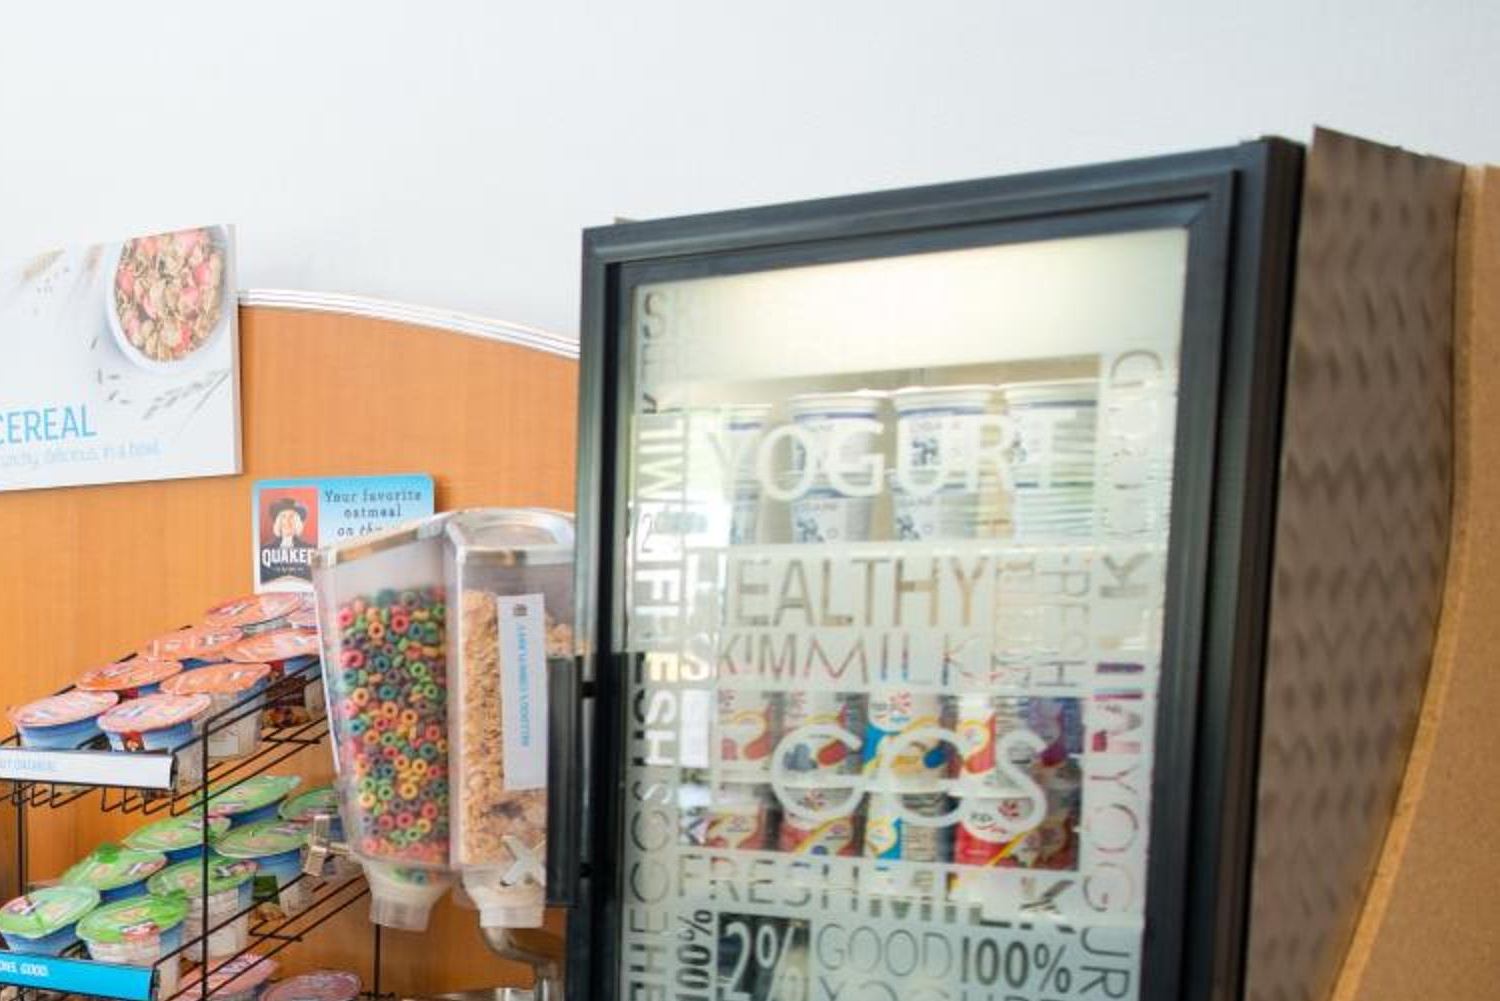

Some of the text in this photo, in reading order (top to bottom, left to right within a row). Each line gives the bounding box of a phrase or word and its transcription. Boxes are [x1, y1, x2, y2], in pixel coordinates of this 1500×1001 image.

[706, 409, 1077, 501] YOGURT
[324, 488, 422, 503] Your favorite
[343, 504, 403, 519] oatmeal
[337, 526, 383, 537] on th
[685, 552, 991, 628] HEALTHY
[676, 852, 1077, 934] FRESH MILK
[816, 923, 1072, 994] GOOD 100%
